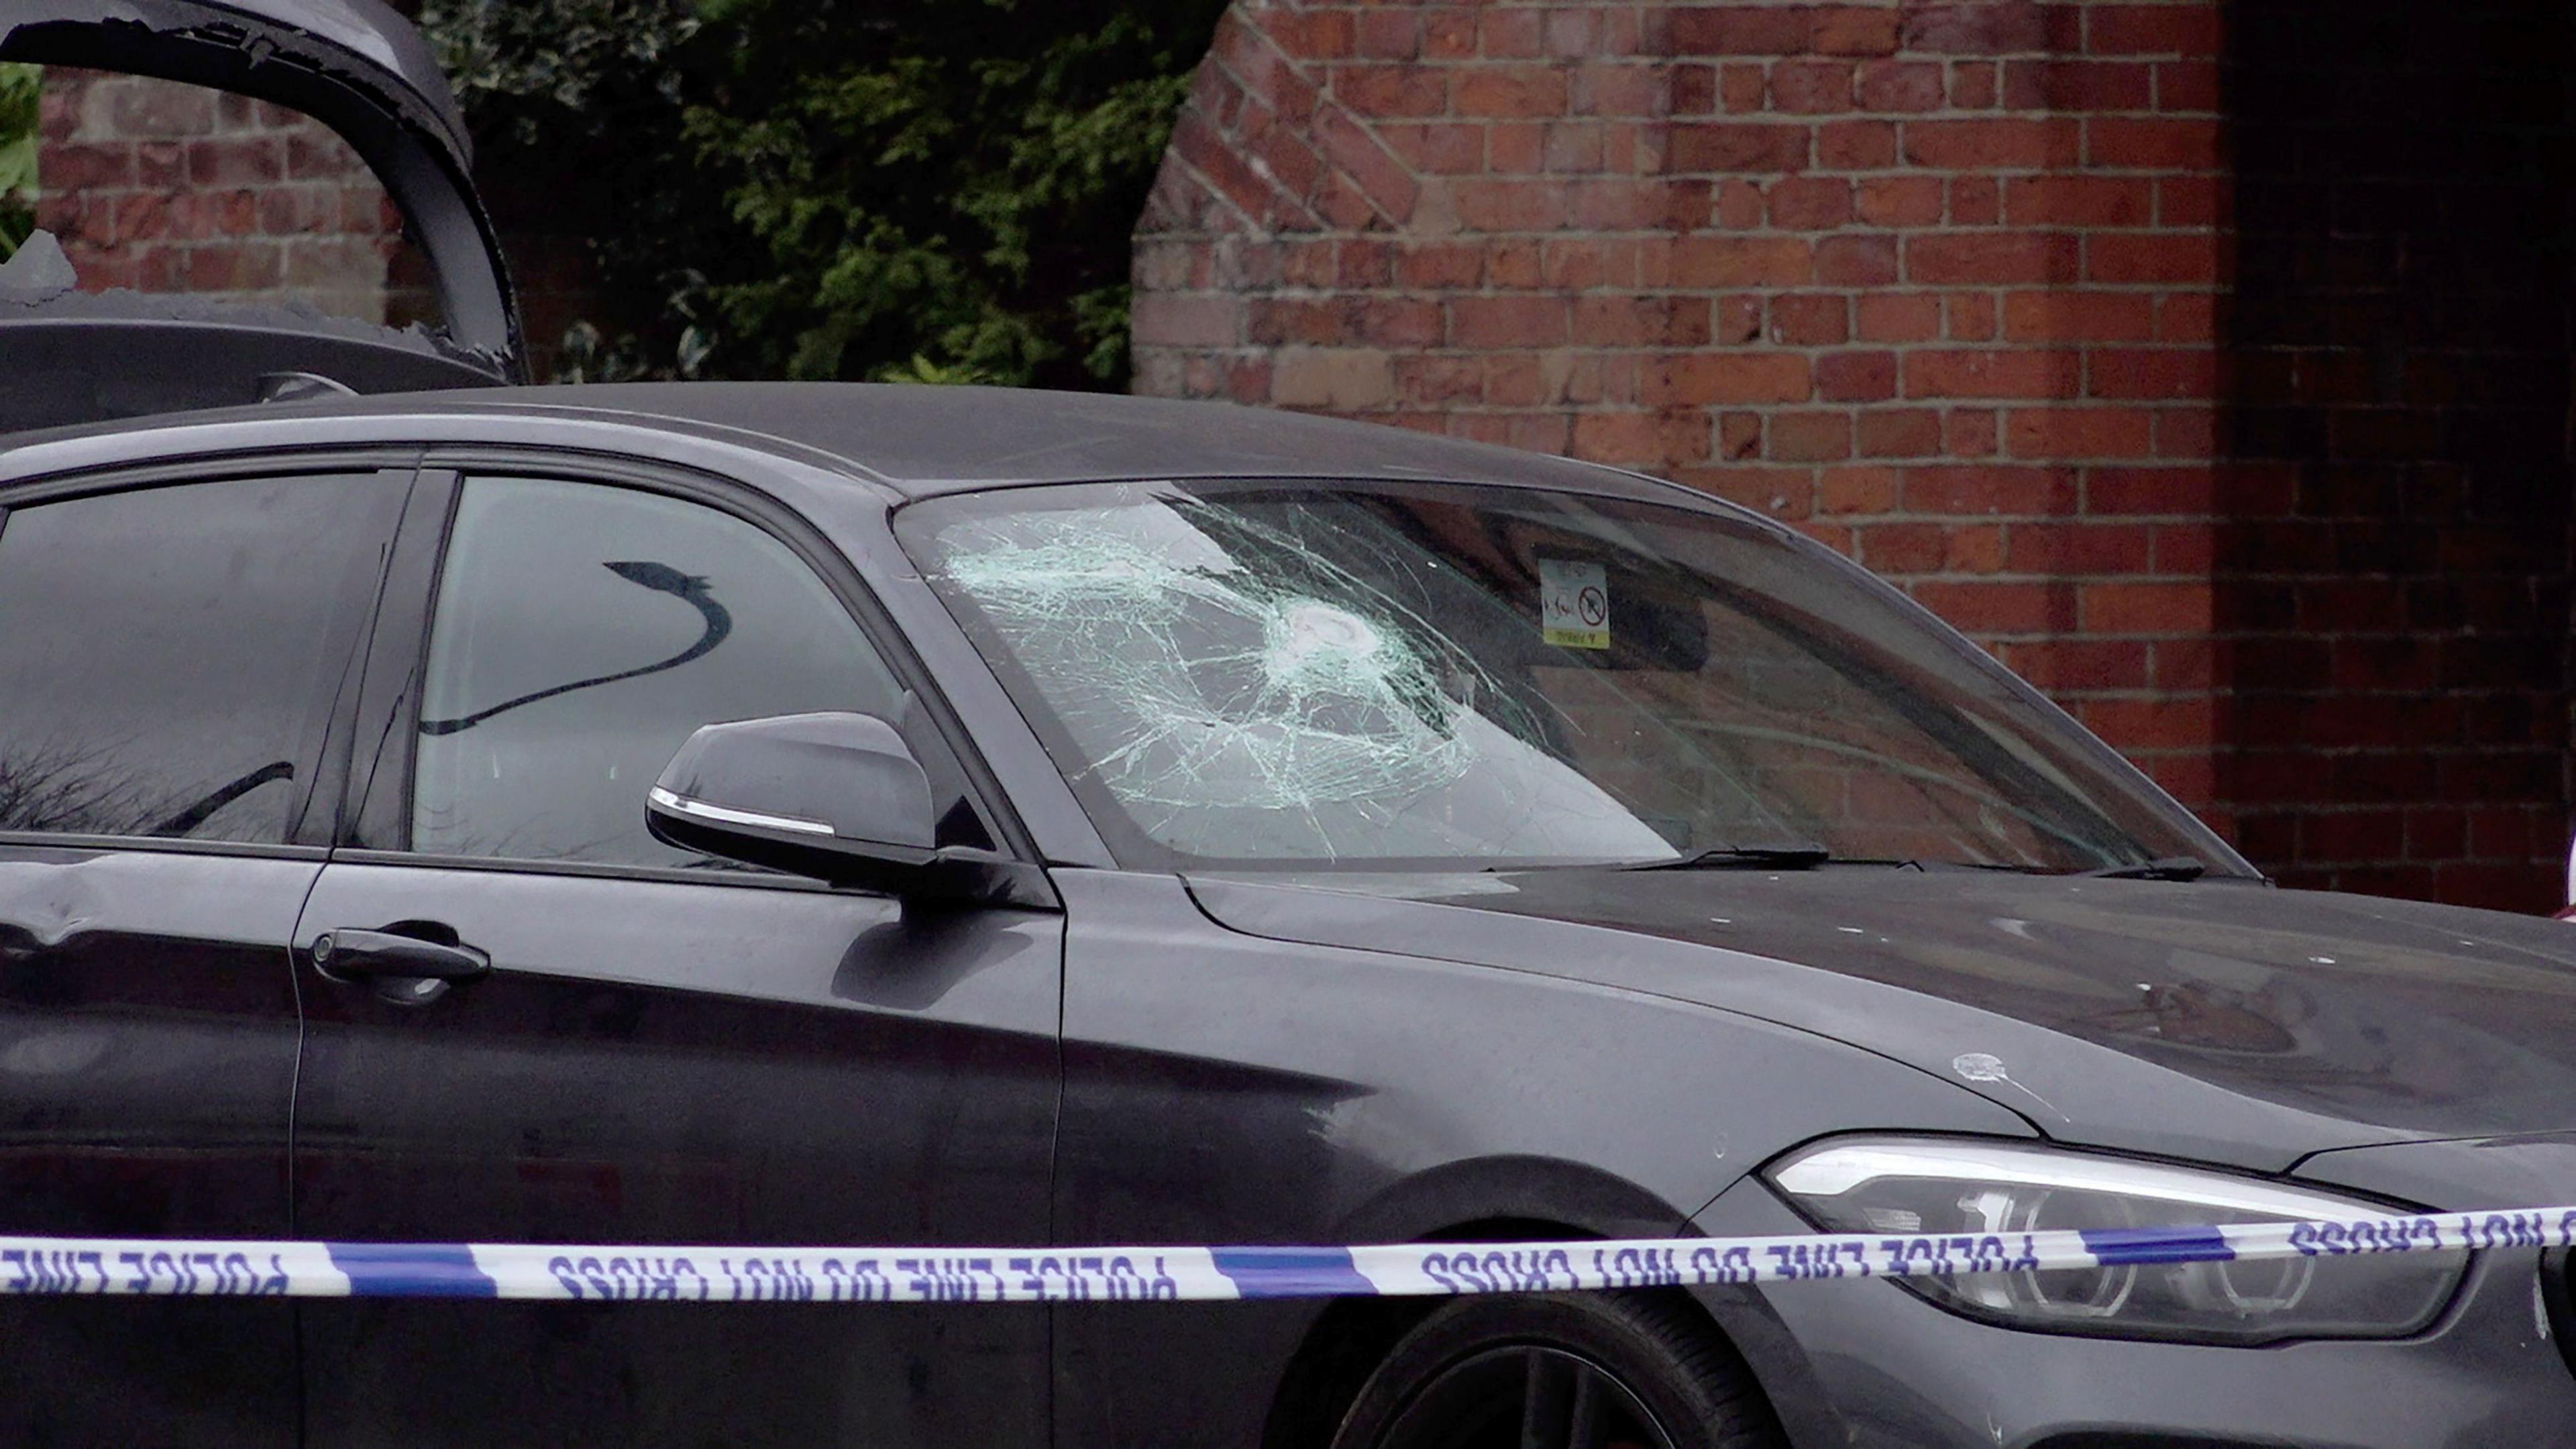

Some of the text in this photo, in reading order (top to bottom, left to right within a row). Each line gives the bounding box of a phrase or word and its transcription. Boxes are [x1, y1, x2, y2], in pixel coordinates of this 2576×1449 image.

[1, 1250, 290, 1294] POLICE LINE
[548, 1256, 1177, 1300] POLICE LINE DO NOT CROSS
[1421, 1235, 2039, 1294] POLICE LINE DO NOT CROSS
